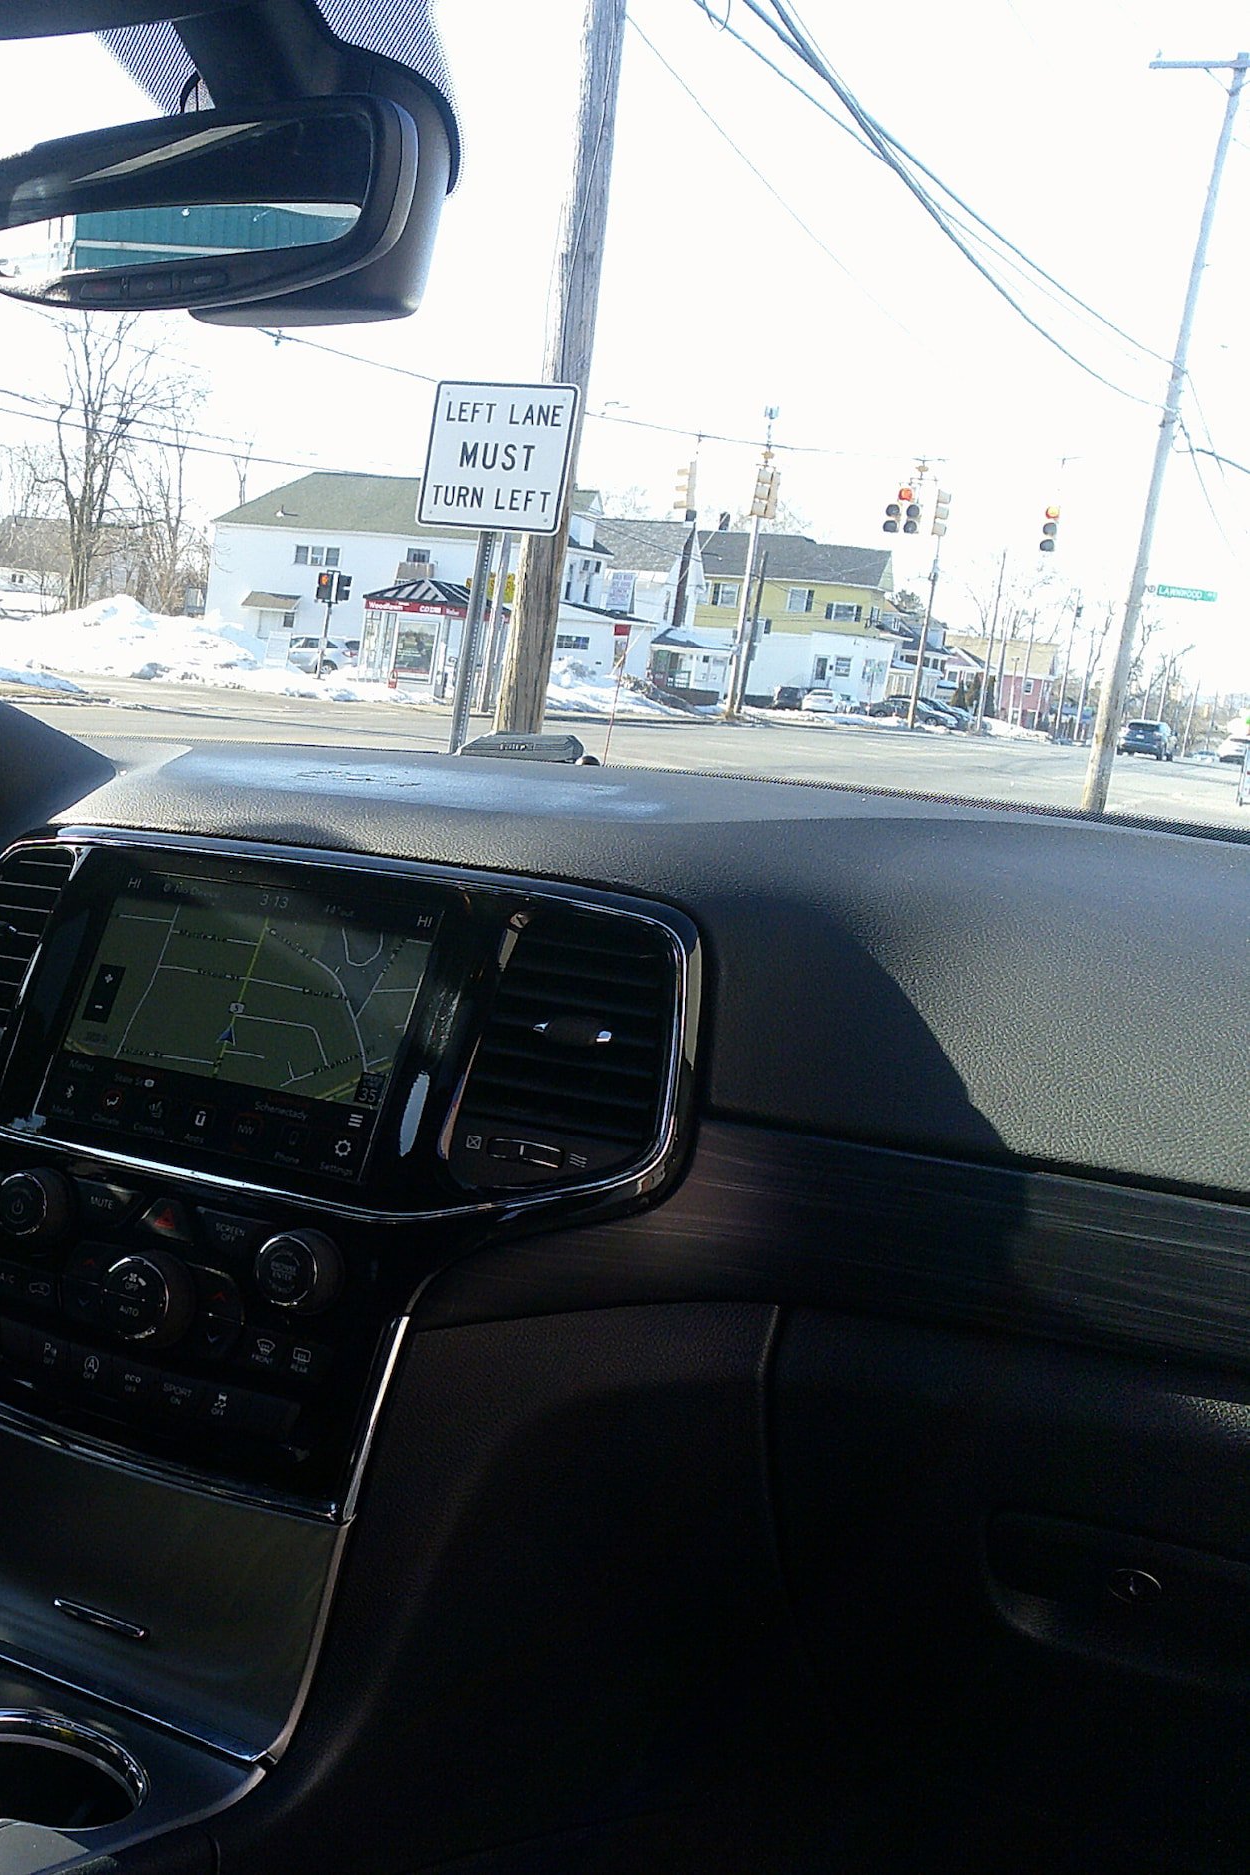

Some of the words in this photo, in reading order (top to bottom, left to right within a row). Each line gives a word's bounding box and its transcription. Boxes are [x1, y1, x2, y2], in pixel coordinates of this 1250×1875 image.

[445, 400, 498, 424] LEFT
[508, 403, 565, 428] LANE
[459, 440, 536, 472] MUST
[432, 484, 485, 509] TURN
[494, 487, 552, 513] LEFT
[127, 877, 142, 889] HI
[416, 914, 435, 928] HI
[68, 1058, 95, 1073] Menu
[358, 1087, 378, 1103] 35
[90, 1195, 114, 1211] MUTE
[0, 1271, 17, 1285] A/C
[119, 1304, 141, 1318] AUTO
[124, 1373, 142, 1384] eco
